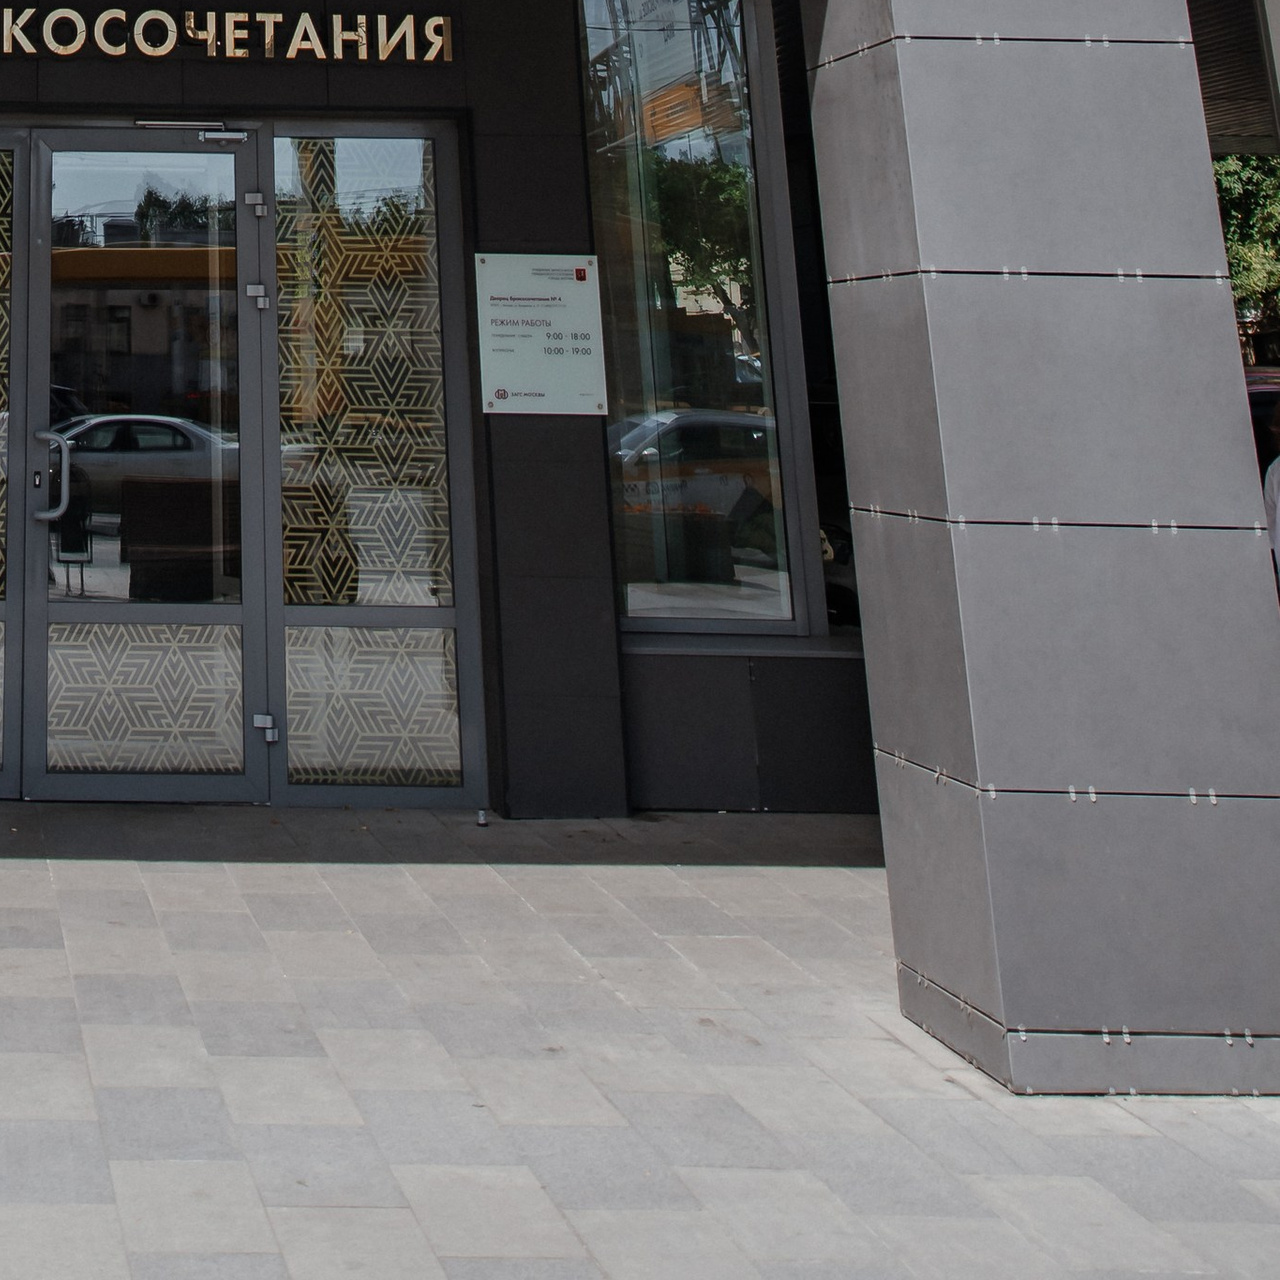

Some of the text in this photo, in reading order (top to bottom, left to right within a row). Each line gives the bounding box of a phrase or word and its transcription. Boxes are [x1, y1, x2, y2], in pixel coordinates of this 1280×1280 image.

[490, 319, 552, 327] РЕЖИМ РАБОТЫ
[570, 332, 591, 341] 18:00
[543, 347, 565, 355] 10:00
[571, 347, 592, 355] 19:00
